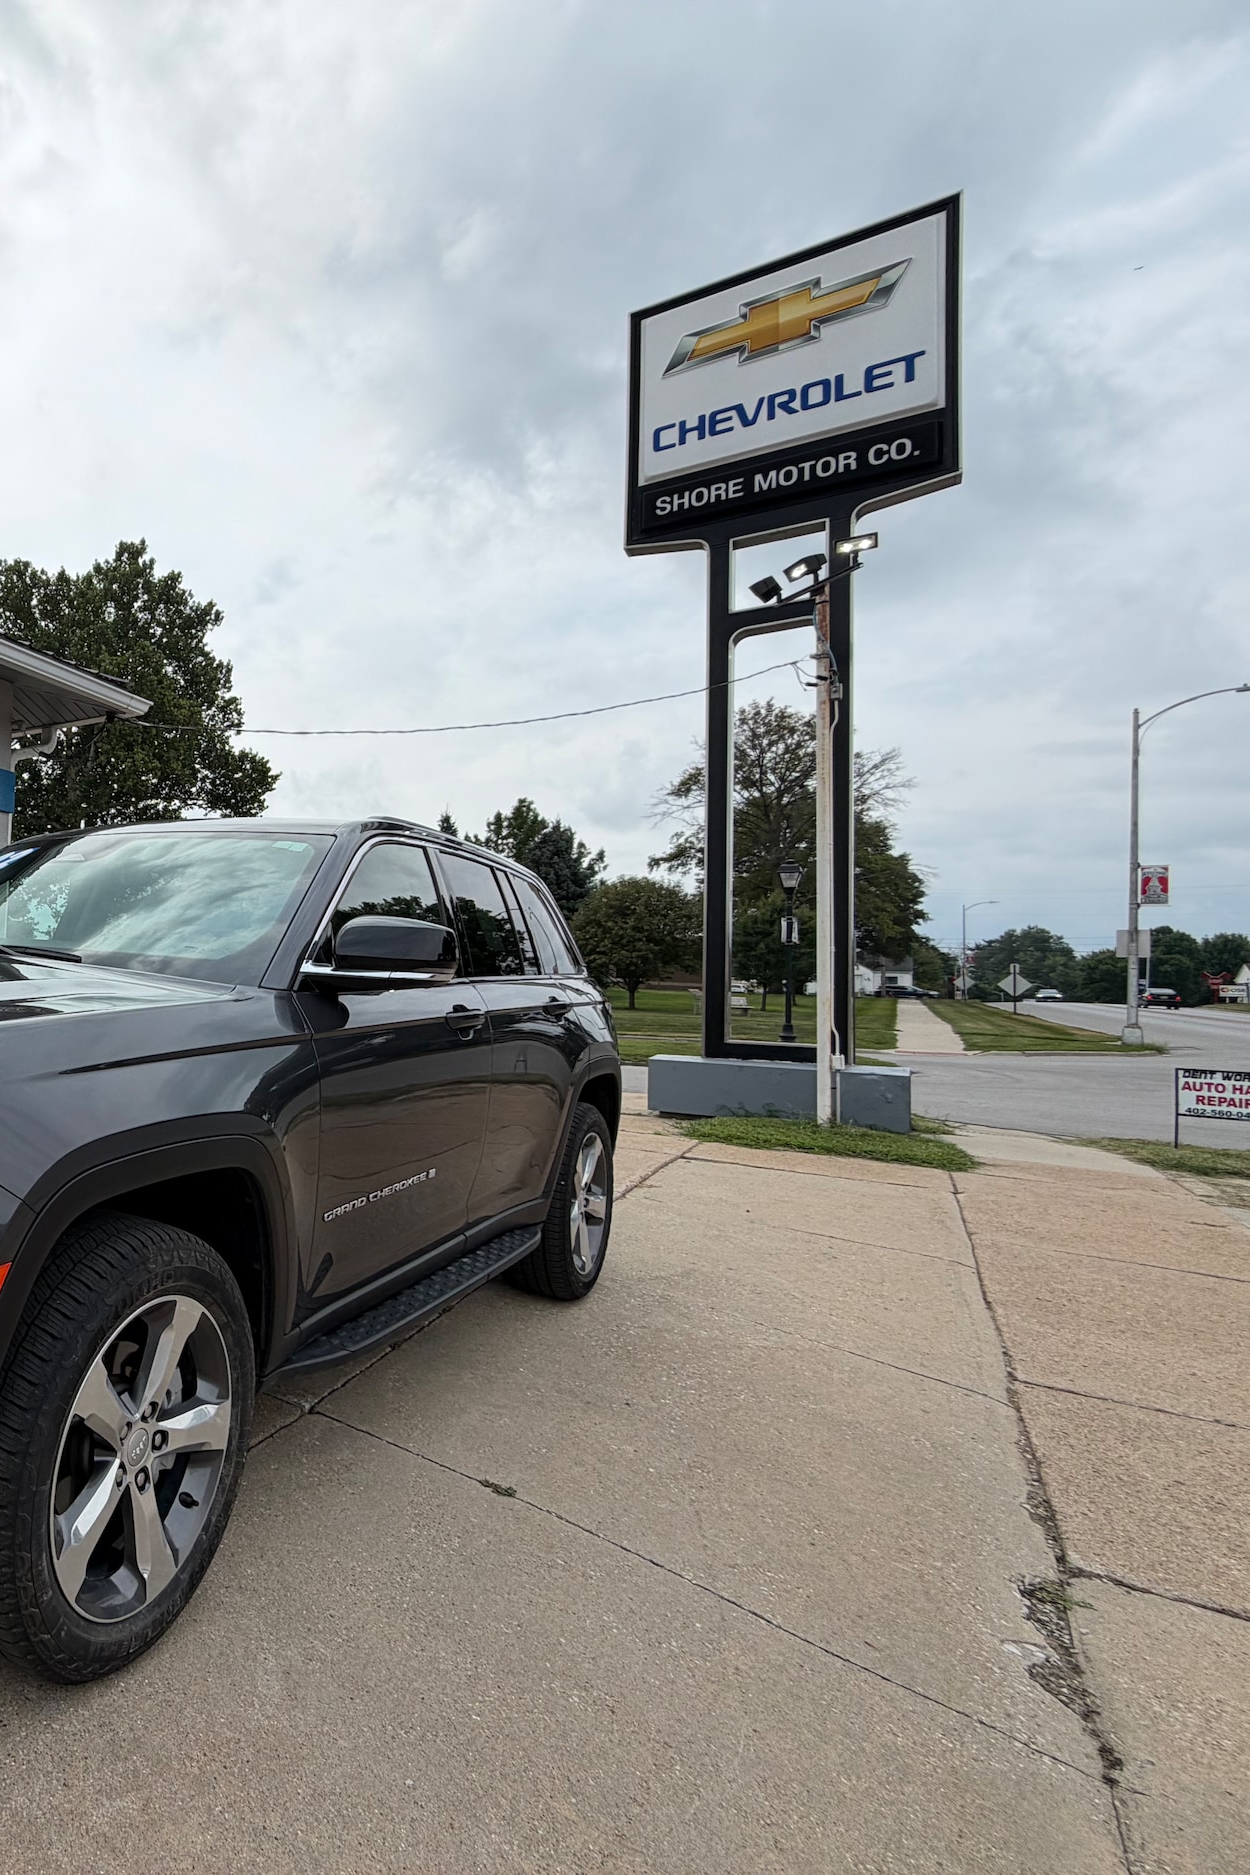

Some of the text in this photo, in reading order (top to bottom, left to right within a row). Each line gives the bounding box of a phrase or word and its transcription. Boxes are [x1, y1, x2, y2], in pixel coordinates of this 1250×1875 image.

[652, 350, 926, 452] CHEVROLET
[655, 437, 921, 516] SHORE MOTOR CO.
[1181, 1081, 1226, 1094] AUTO
[323, 1172, 427, 1222] GRAND CHEROKEE
